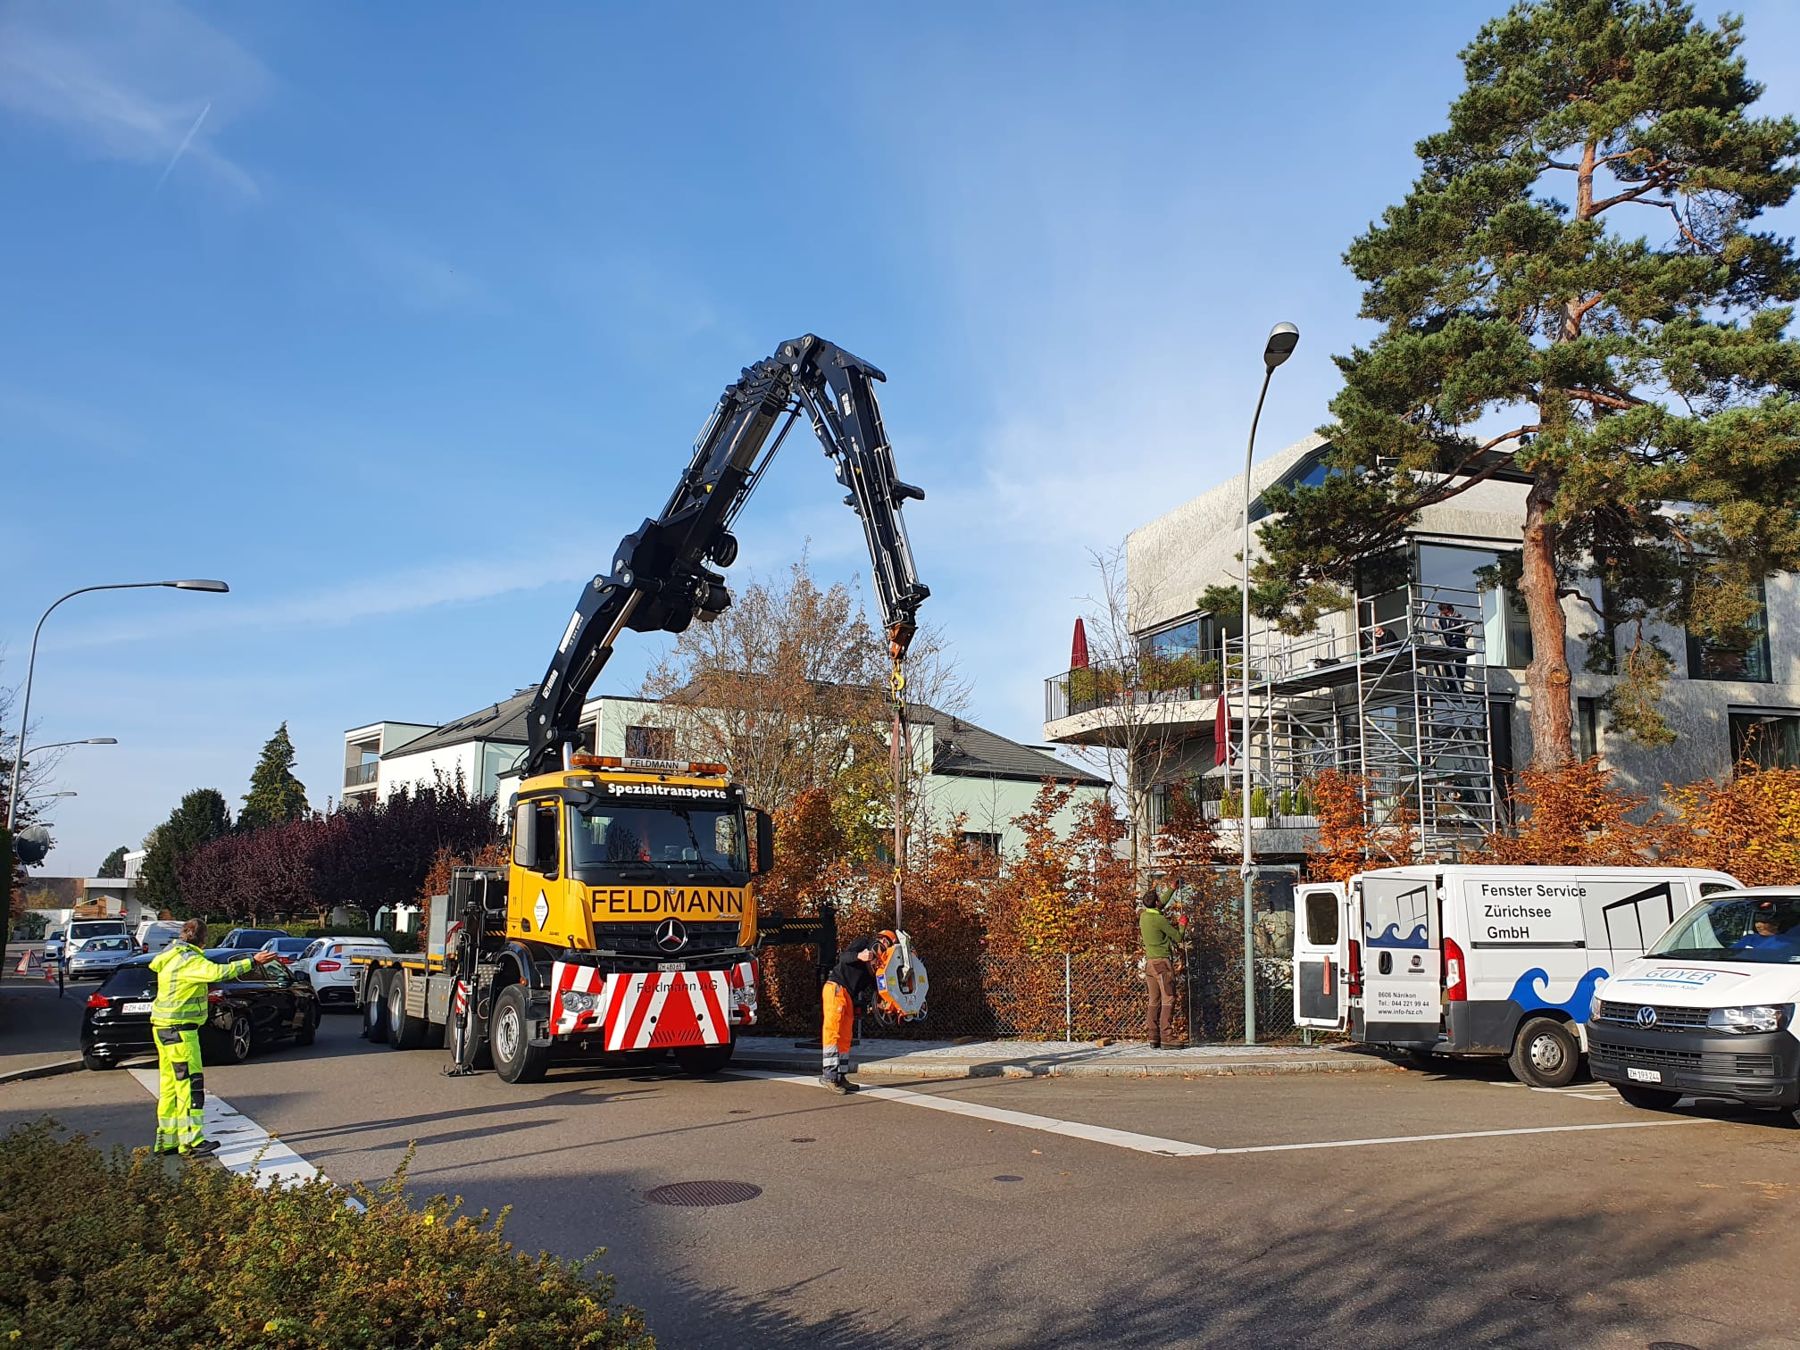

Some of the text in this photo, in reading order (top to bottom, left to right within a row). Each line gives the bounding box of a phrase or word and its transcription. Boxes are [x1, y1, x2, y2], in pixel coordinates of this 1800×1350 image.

[630, 759, 679, 770] FELDMANN
[608, 783, 727, 799] Spezialtransporte
[1481, 884, 1587, 897] Fenster Service
[592, 889, 743, 913] FELDMANN
[1484, 905, 1551, 918] Zürichsee
[1487, 926, 1530, 939] GmbH
[1646, 970, 1717, 982] GUYER
[637, 982, 697, 993] Feldmann
